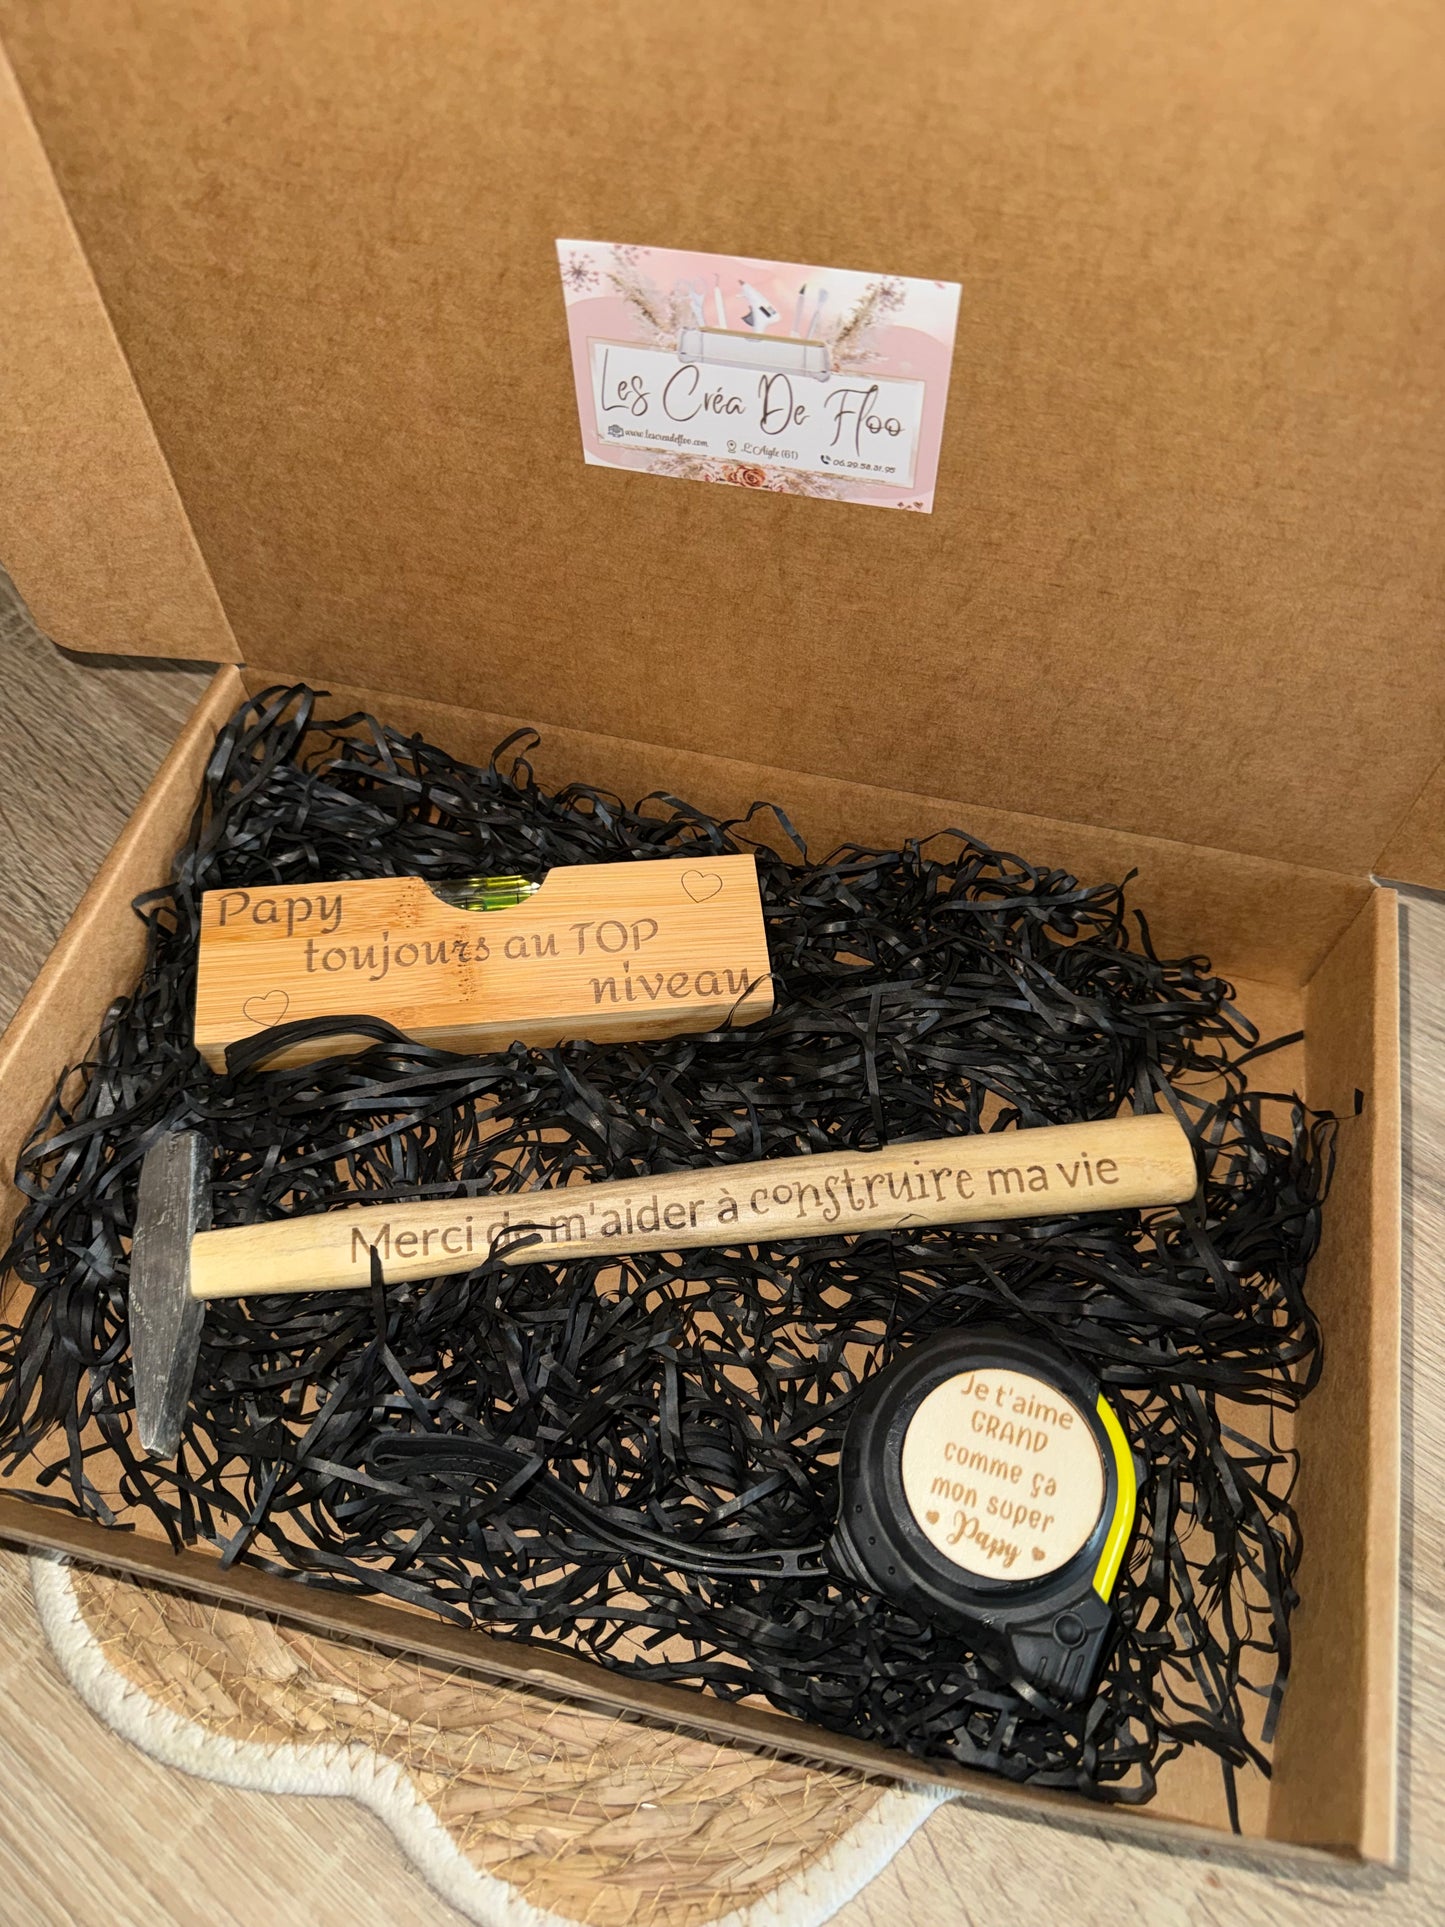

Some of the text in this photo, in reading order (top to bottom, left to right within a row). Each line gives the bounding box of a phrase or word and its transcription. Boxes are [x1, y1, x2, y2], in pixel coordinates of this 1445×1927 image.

[601, 348, 906, 457] Les Créa De Floo
[217, 890, 344, 936] Papy
[303, 917, 660, 983] toujours au TOP
[590, 960, 750, 1004] niveau
[351, 1215, 474, 1264] Merci
[549, 1195, 705, 1243] m'aider
[716, 1187, 740, 1224] à
[750, 1159, 976, 1222] construire
[987, 1164, 1050, 1196] ma
[1056, 1151, 1120, 1187] vie
[960, 1374, 1074, 1430] Je t'aime
[970, 1409, 1049, 1454] GRAND
[944, 1441, 1057, 1499] comme ça
[930, 1476, 1055, 1533] mon super
[946, 1510, 1022, 1569] Papy
